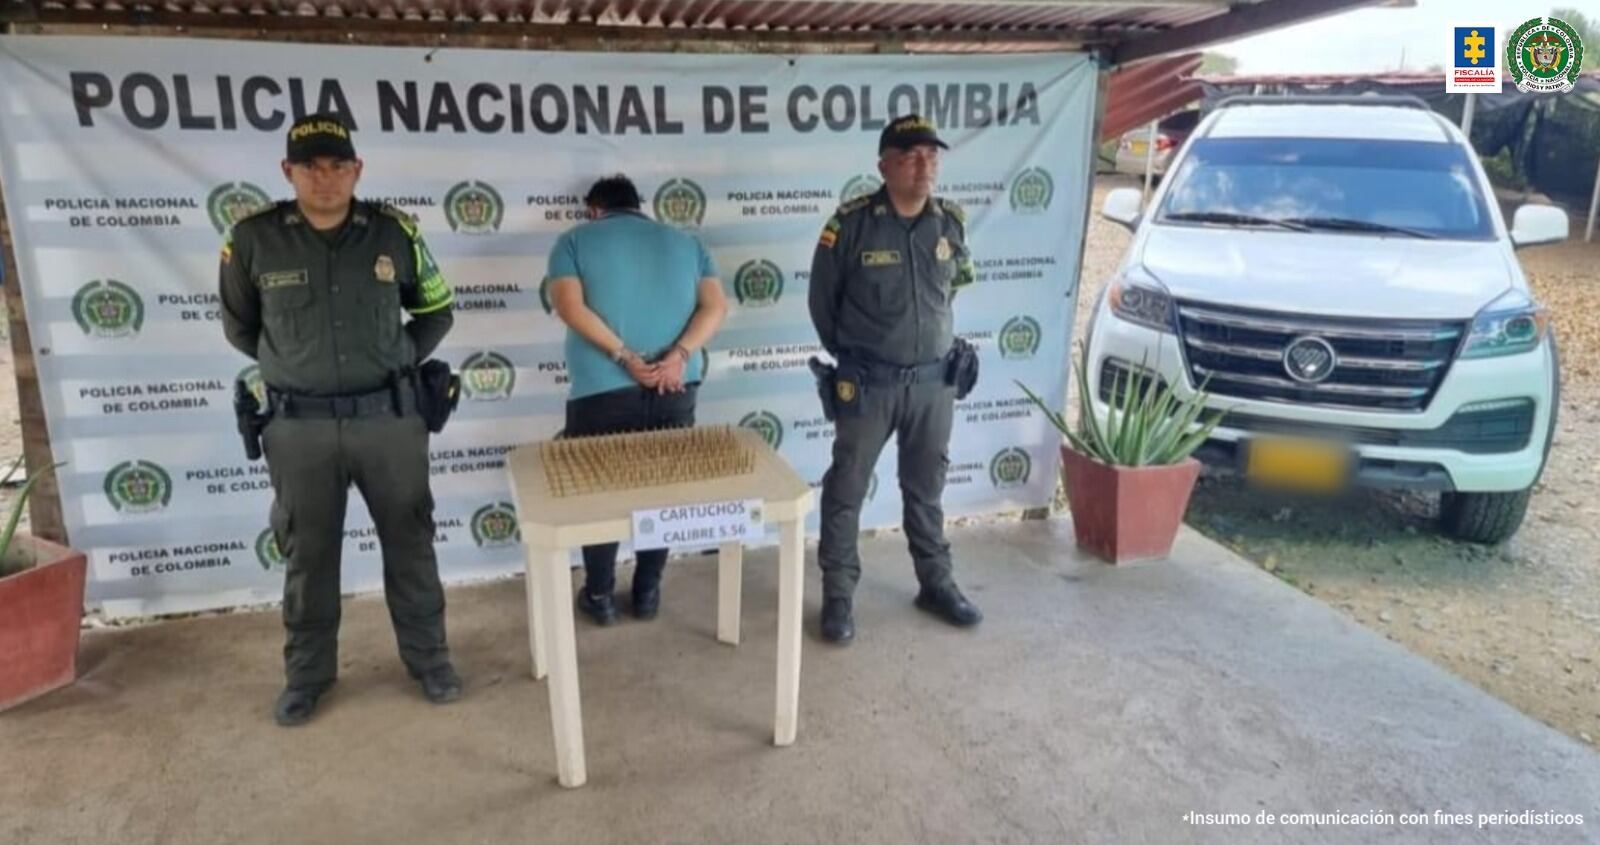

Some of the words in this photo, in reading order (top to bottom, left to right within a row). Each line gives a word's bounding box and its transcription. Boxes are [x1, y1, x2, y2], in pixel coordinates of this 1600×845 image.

[69, 71, 358, 131] POLICIA
[376, 79, 684, 134] NACIONAL
[703, 85, 770, 133] DE
[787, 82, 1041, 133] COLOMBIA
[291, 120, 348, 140] POLICIA
[527, 194, 580, 206] POLICIA
[728, 191, 775, 201] POLICIA
[777, 189, 834, 200] NACIONAL
[45, 198, 109, 210] POLICIA
[115, 196, 199, 209] NACIONAL
[743, 206, 757, 215] DE
[761, 204, 820, 214] COLOMBIA
[70, 216, 91, 227] DE
[96, 214, 180, 226] COLOMBIA
[545, 210, 560, 220] DE
[455, 283, 522, 294] NACIONAL
[158, 293, 219, 305] POLICIA
[450, 299, 506, 310] OLOMBIA
[181, 310, 201, 320] DE
[728, 347, 772, 358] POLICIA
[776, 343, 823, 354] NACIONA
[538, 361, 566, 372] POLI
[743, 362, 757, 371] DE
[761, 358, 806, 370] COLOMB
[79, 384, 142, 398] POLICIA
[147, 380, 226, 393] NACIONAL
[103, 403, 122, 414] DE
[128, 397, 208, 411] COLOMBIA
[430, 449, 464, 461] LICIA
[186, 466, 244, 480] POLICIA
[451, 460, 505, 473] COLOMB
[207, 484, 226, 494] DE
[230, 480, 269, 492] COLO
[660, 500, 745, 522] CARTUCHOS
[663, 526, 714, 543] CALIBRE
[109, 549, 168, 563] POLICIA
[173, 541, 247, 555] NACIONAL
[359, 541, 376, 551] DE
[131, 566, 150, 577] DE
[155, 557, 231, 573] COLOMBIA
